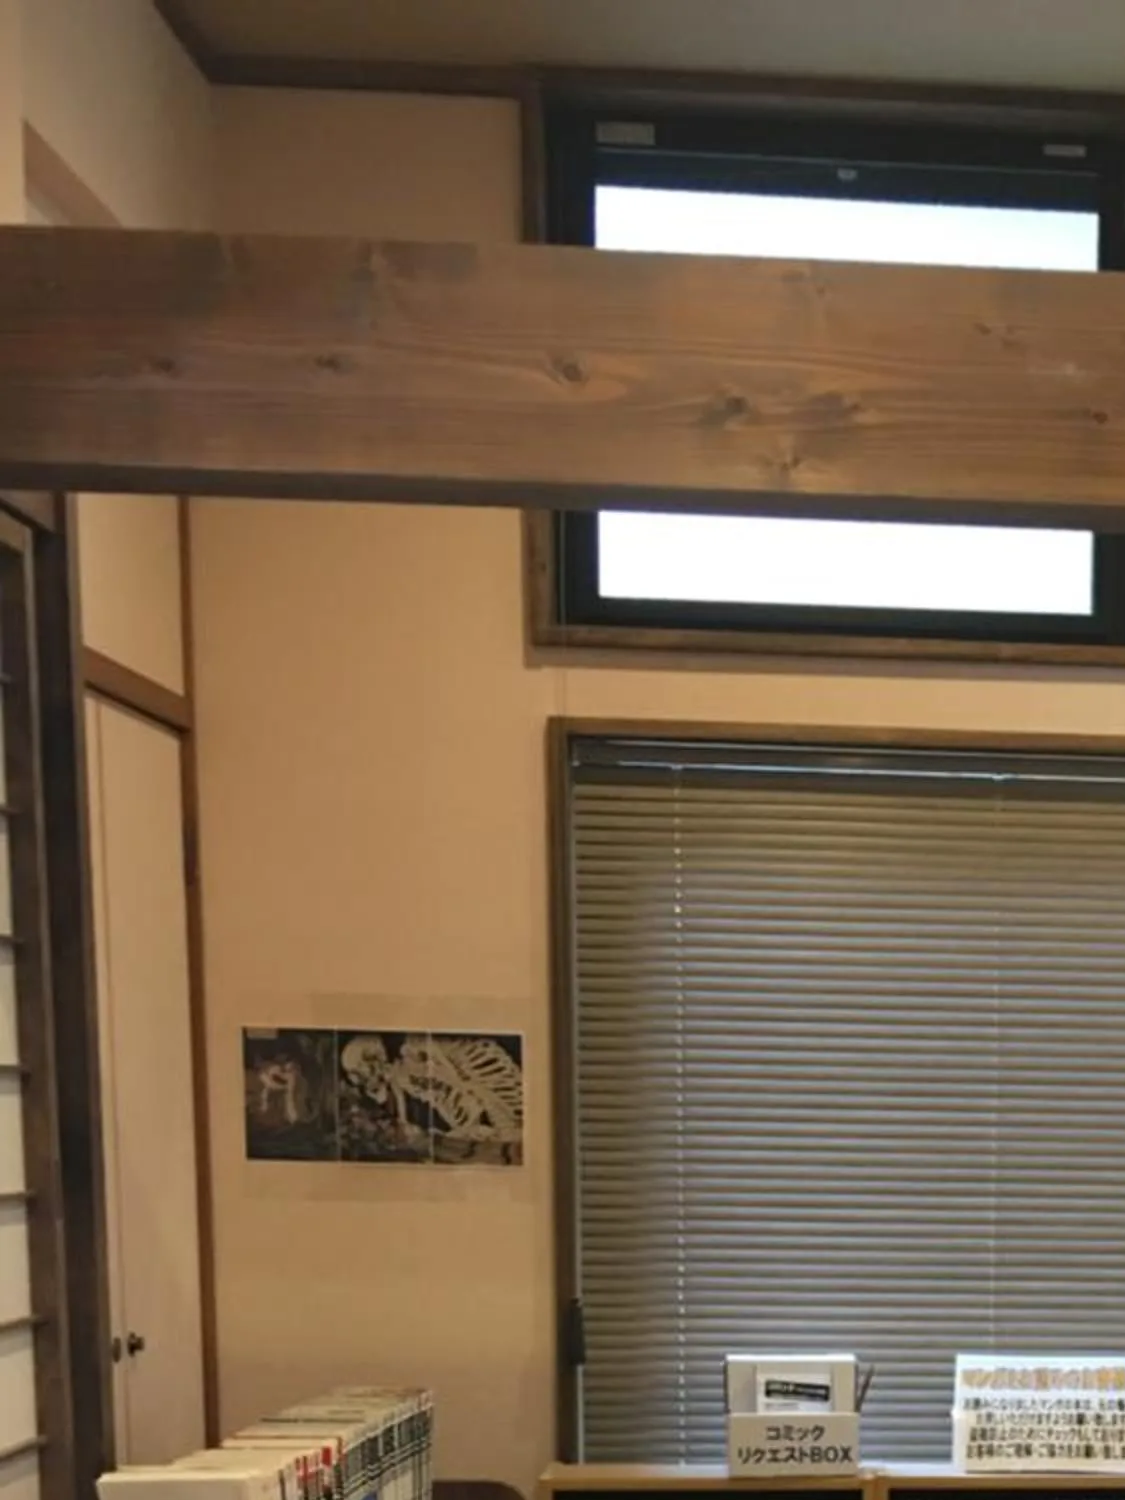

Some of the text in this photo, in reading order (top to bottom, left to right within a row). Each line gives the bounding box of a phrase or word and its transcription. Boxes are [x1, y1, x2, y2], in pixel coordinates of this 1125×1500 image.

[766, 1424, 825, 1441] コミック
[737, 1445, 853, 1464] リクエストBOX
